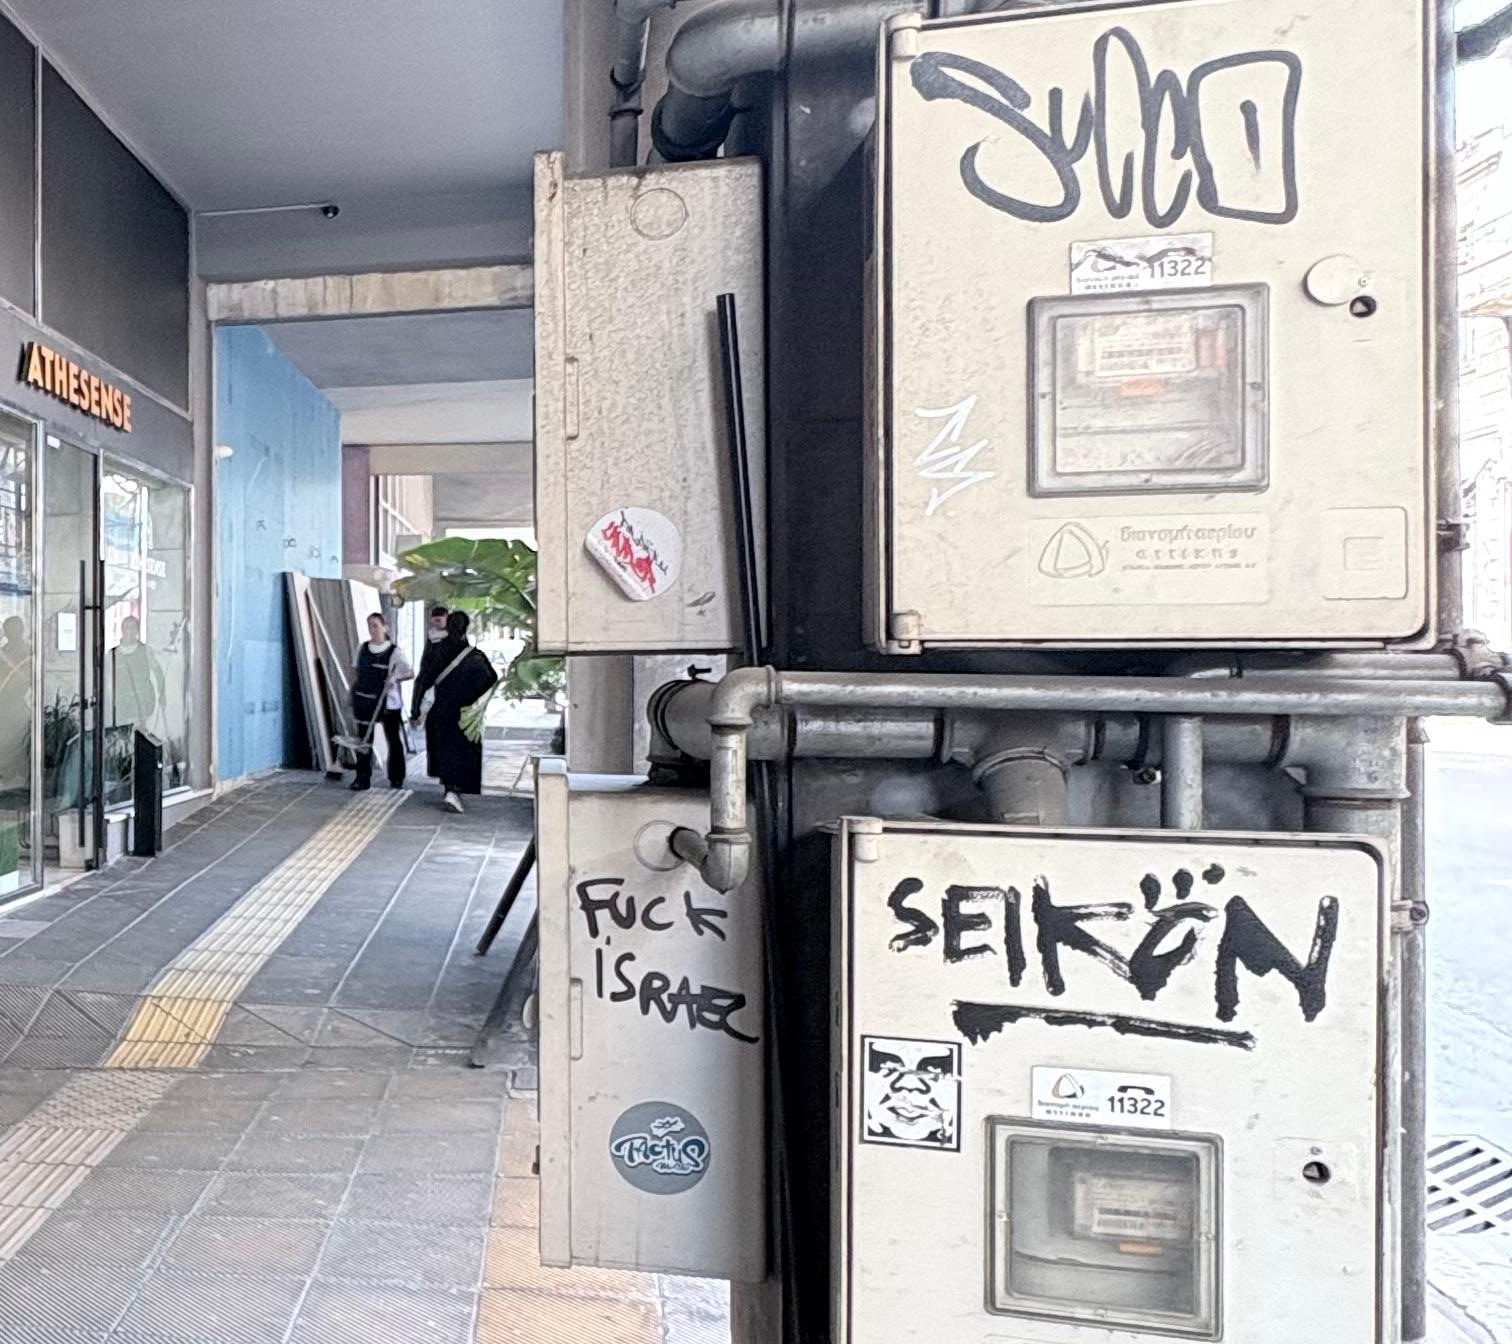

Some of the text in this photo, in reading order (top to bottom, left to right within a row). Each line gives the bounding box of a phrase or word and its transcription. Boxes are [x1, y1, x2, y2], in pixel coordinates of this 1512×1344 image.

[1143, 256, 1207, 279] 11322
[26, 341, 132, 434] ATHESENSE
[575, 877, 728, 942] FUCK
[1106, 1095, 1166, 1118] 11322
